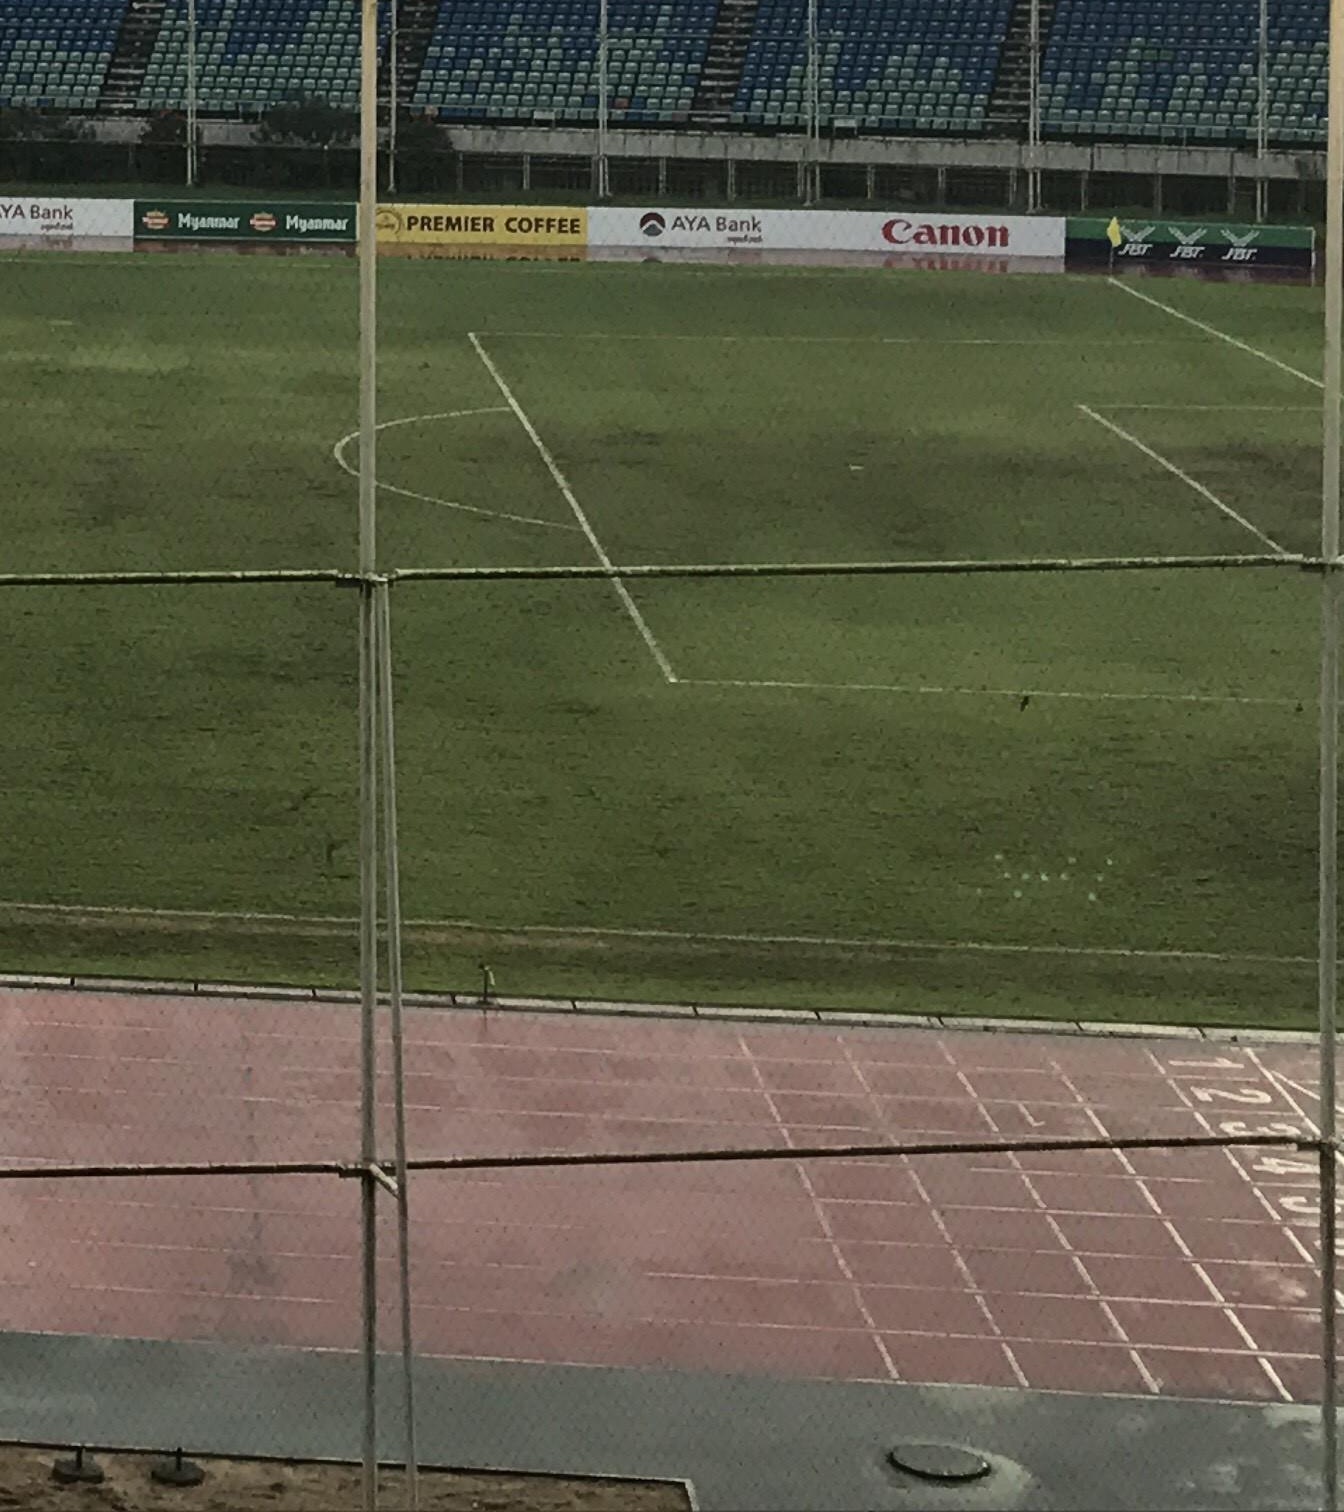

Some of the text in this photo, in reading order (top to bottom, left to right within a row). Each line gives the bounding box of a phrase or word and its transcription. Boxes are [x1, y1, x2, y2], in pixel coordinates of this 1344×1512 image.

[30, 204, 73, 220] Bank
[178, 213, 349, 233] Myanmar Myanmar
[407, 215, 581, 234] PREMIER COFFEE
[671, 216, 762, 233] AYA Bank
[881, 218, 1010, 247] Canon
